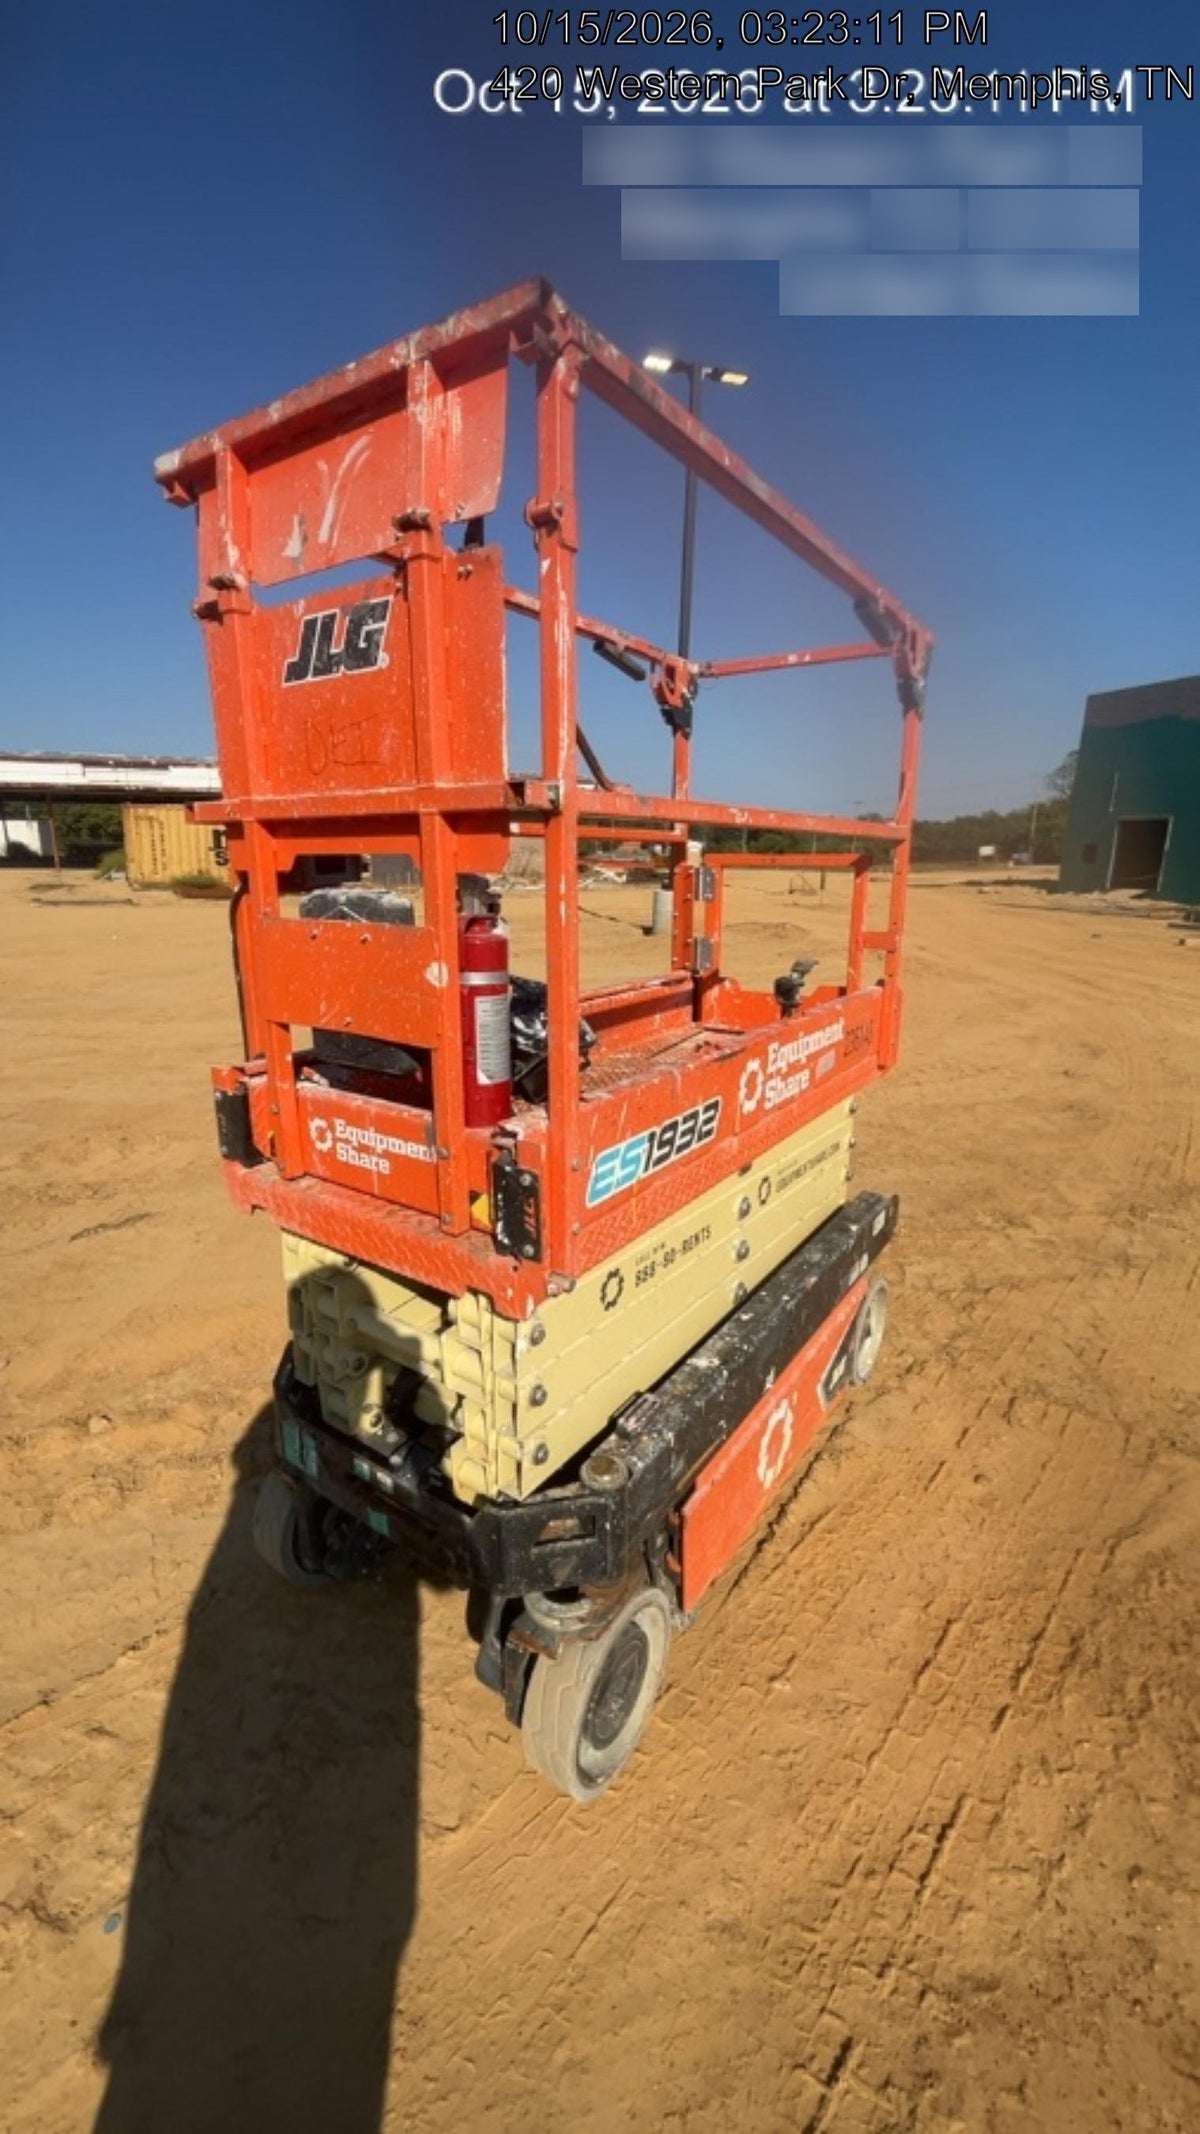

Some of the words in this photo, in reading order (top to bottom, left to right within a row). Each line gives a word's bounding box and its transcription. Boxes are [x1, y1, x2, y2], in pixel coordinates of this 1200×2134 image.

[282, 595, 394, 687] JLG
[766, 1016, 845, 1075] Equipment
[764, 1068, 810, 1111] Share
[336, 1142, 390, 1175] Share
[586, 1096, 722, 1208] ES1932
